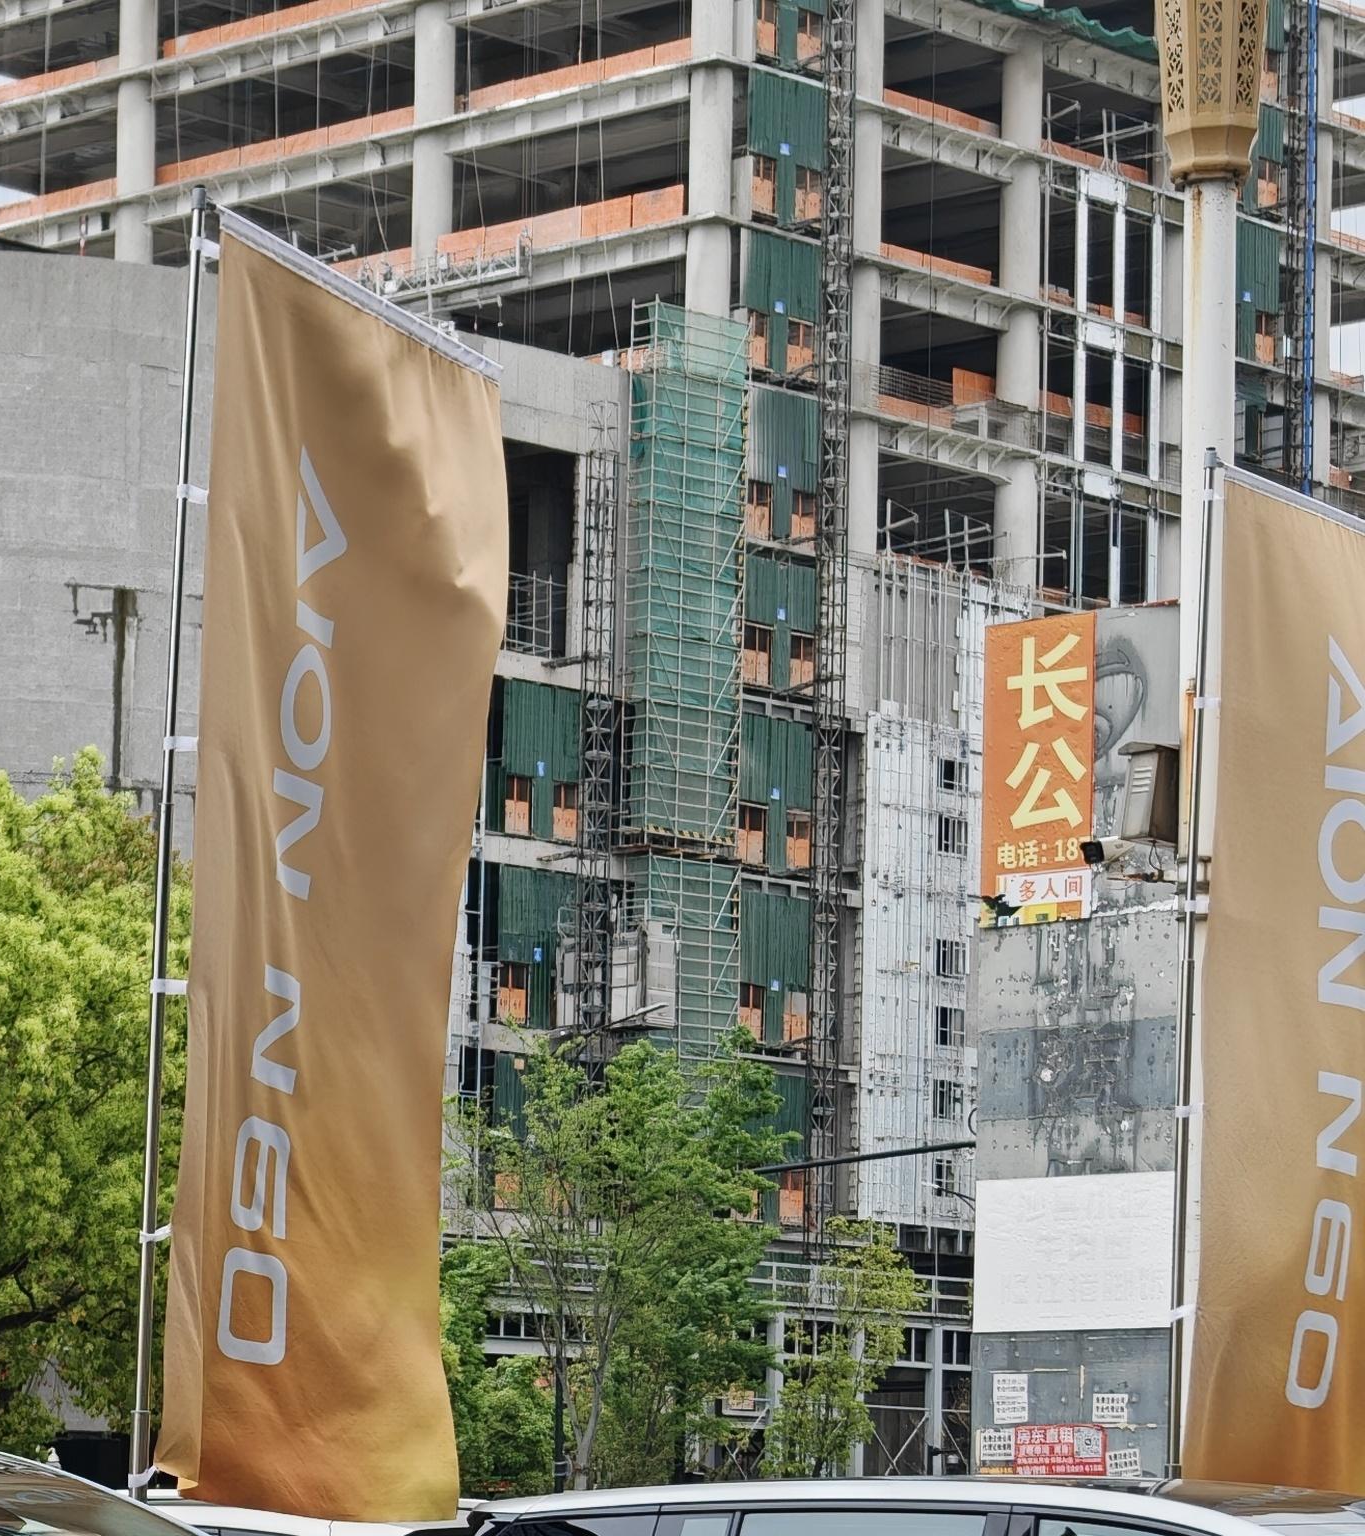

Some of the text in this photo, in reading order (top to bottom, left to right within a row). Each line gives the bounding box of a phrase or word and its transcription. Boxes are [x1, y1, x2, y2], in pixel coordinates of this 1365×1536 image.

[217, 445, 347, 1365] AION N60
[997, 836, 1090, 869] 电话：18
[1285, 1071, 1362, 1409] N60
